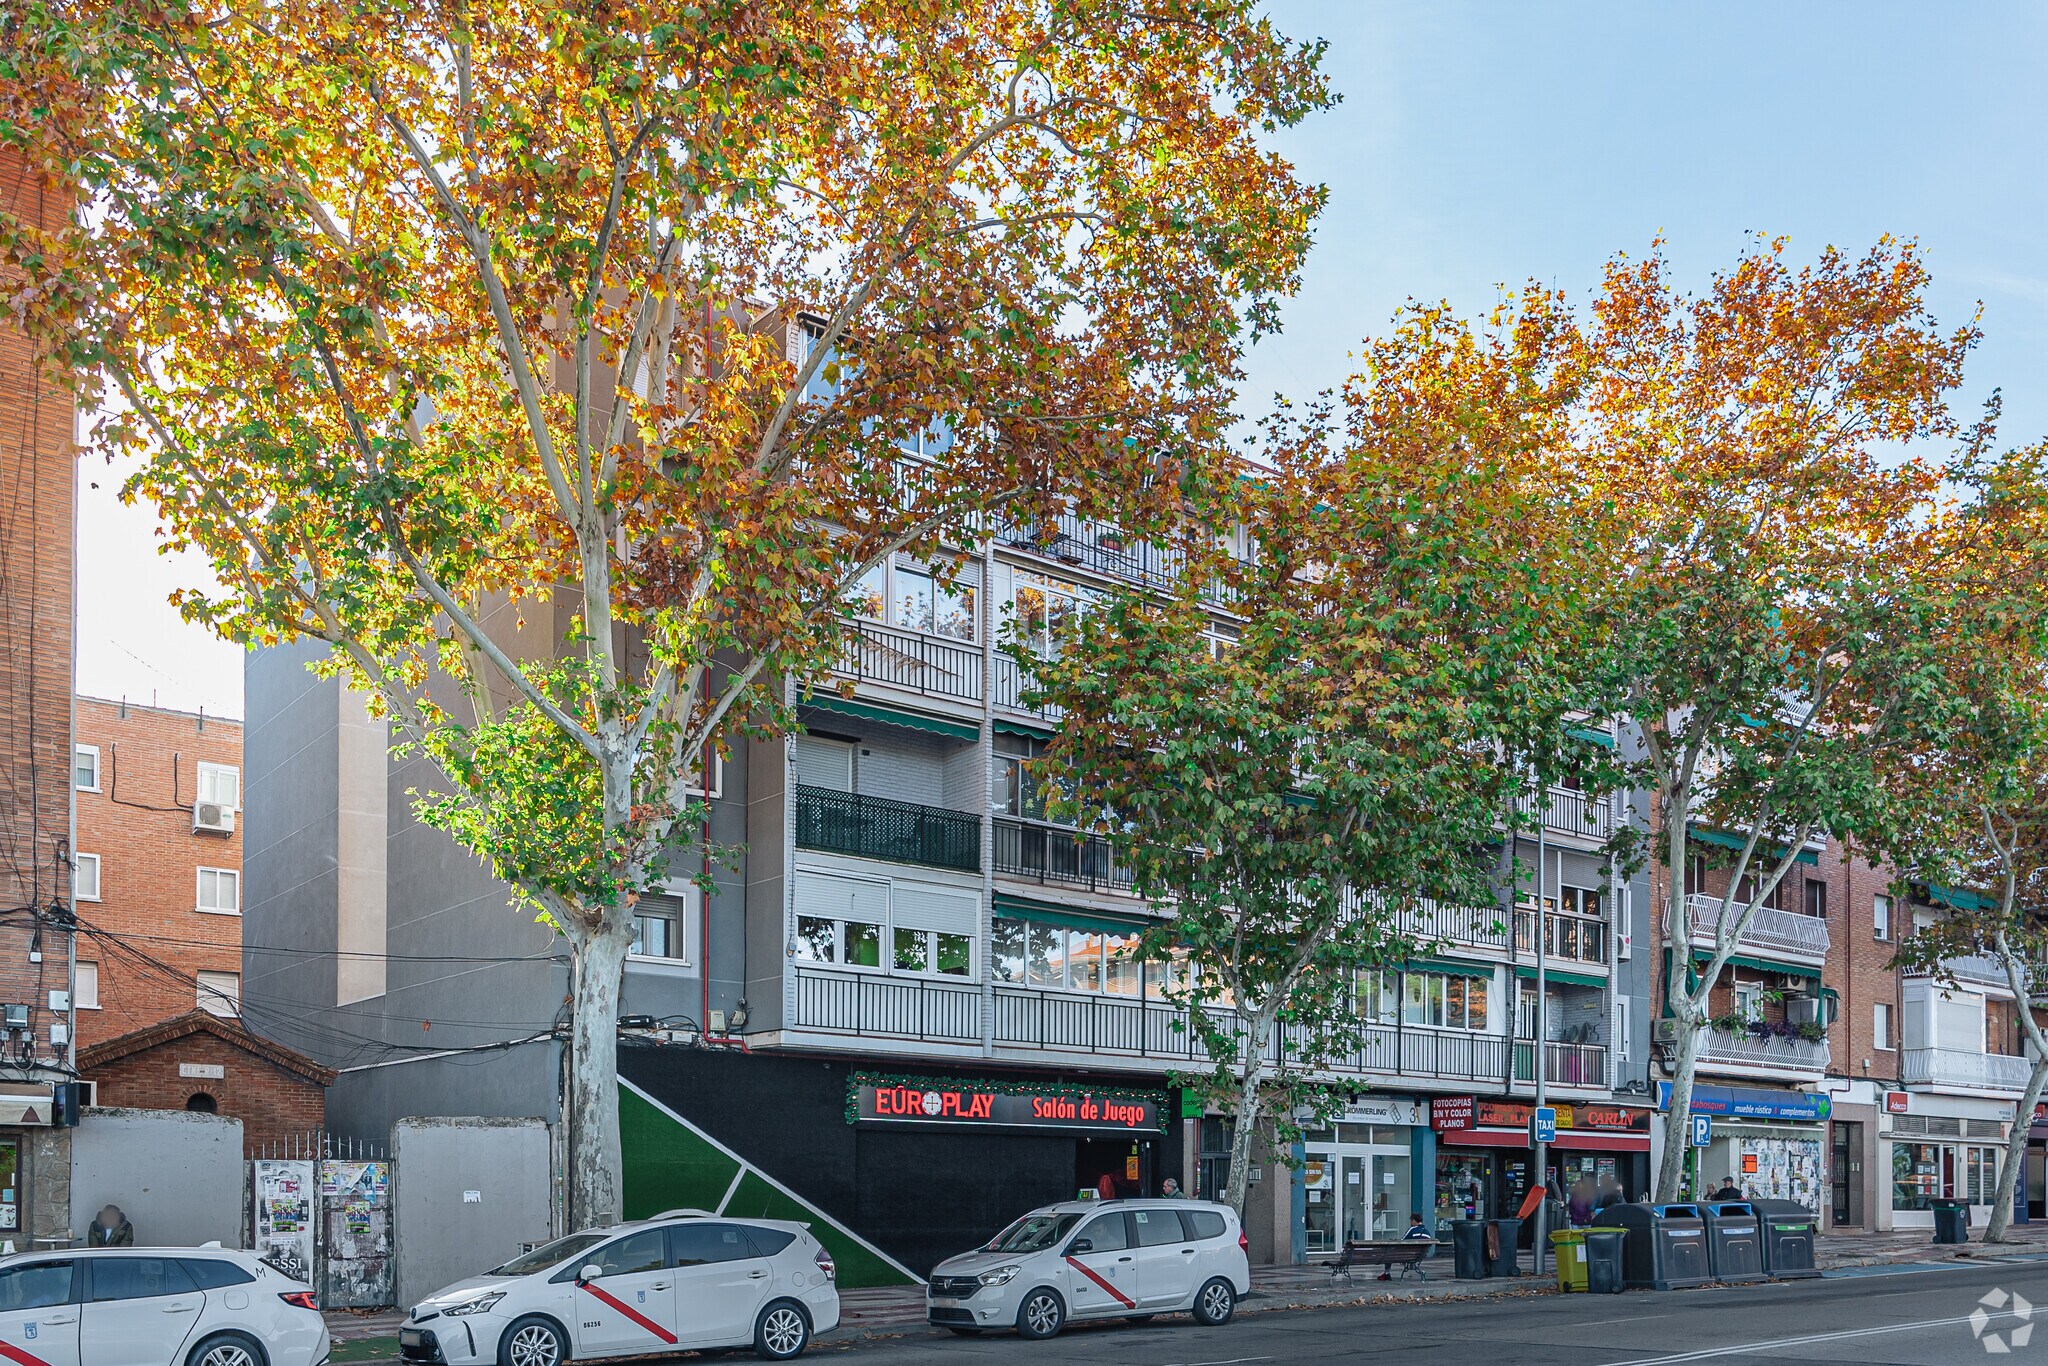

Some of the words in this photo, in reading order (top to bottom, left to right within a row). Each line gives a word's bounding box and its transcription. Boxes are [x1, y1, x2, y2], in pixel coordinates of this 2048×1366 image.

[1433, 1098, 1472, 1107] FOTOCOPIAS
[1032, 1097, 1075, 1119] Salón
[1080, 1098, 1098, 1120] de
[1102, 1100, 1145, 1127] Juego
[1444, 1109, 1450, 1118] Y
[1450, 1108, 1472, 1117] COLOR
[1734, 1104, 1754, 1115] mueble
[1780, 1107, 1816, 1119] complementos
[1478, 1113, 1504, 1122] LASER
[1538, 1120, 1554, 1130] TAXI
[1696, 1119, 1708, 1143] P
[268, 1258, 302, 1270] ESSI
